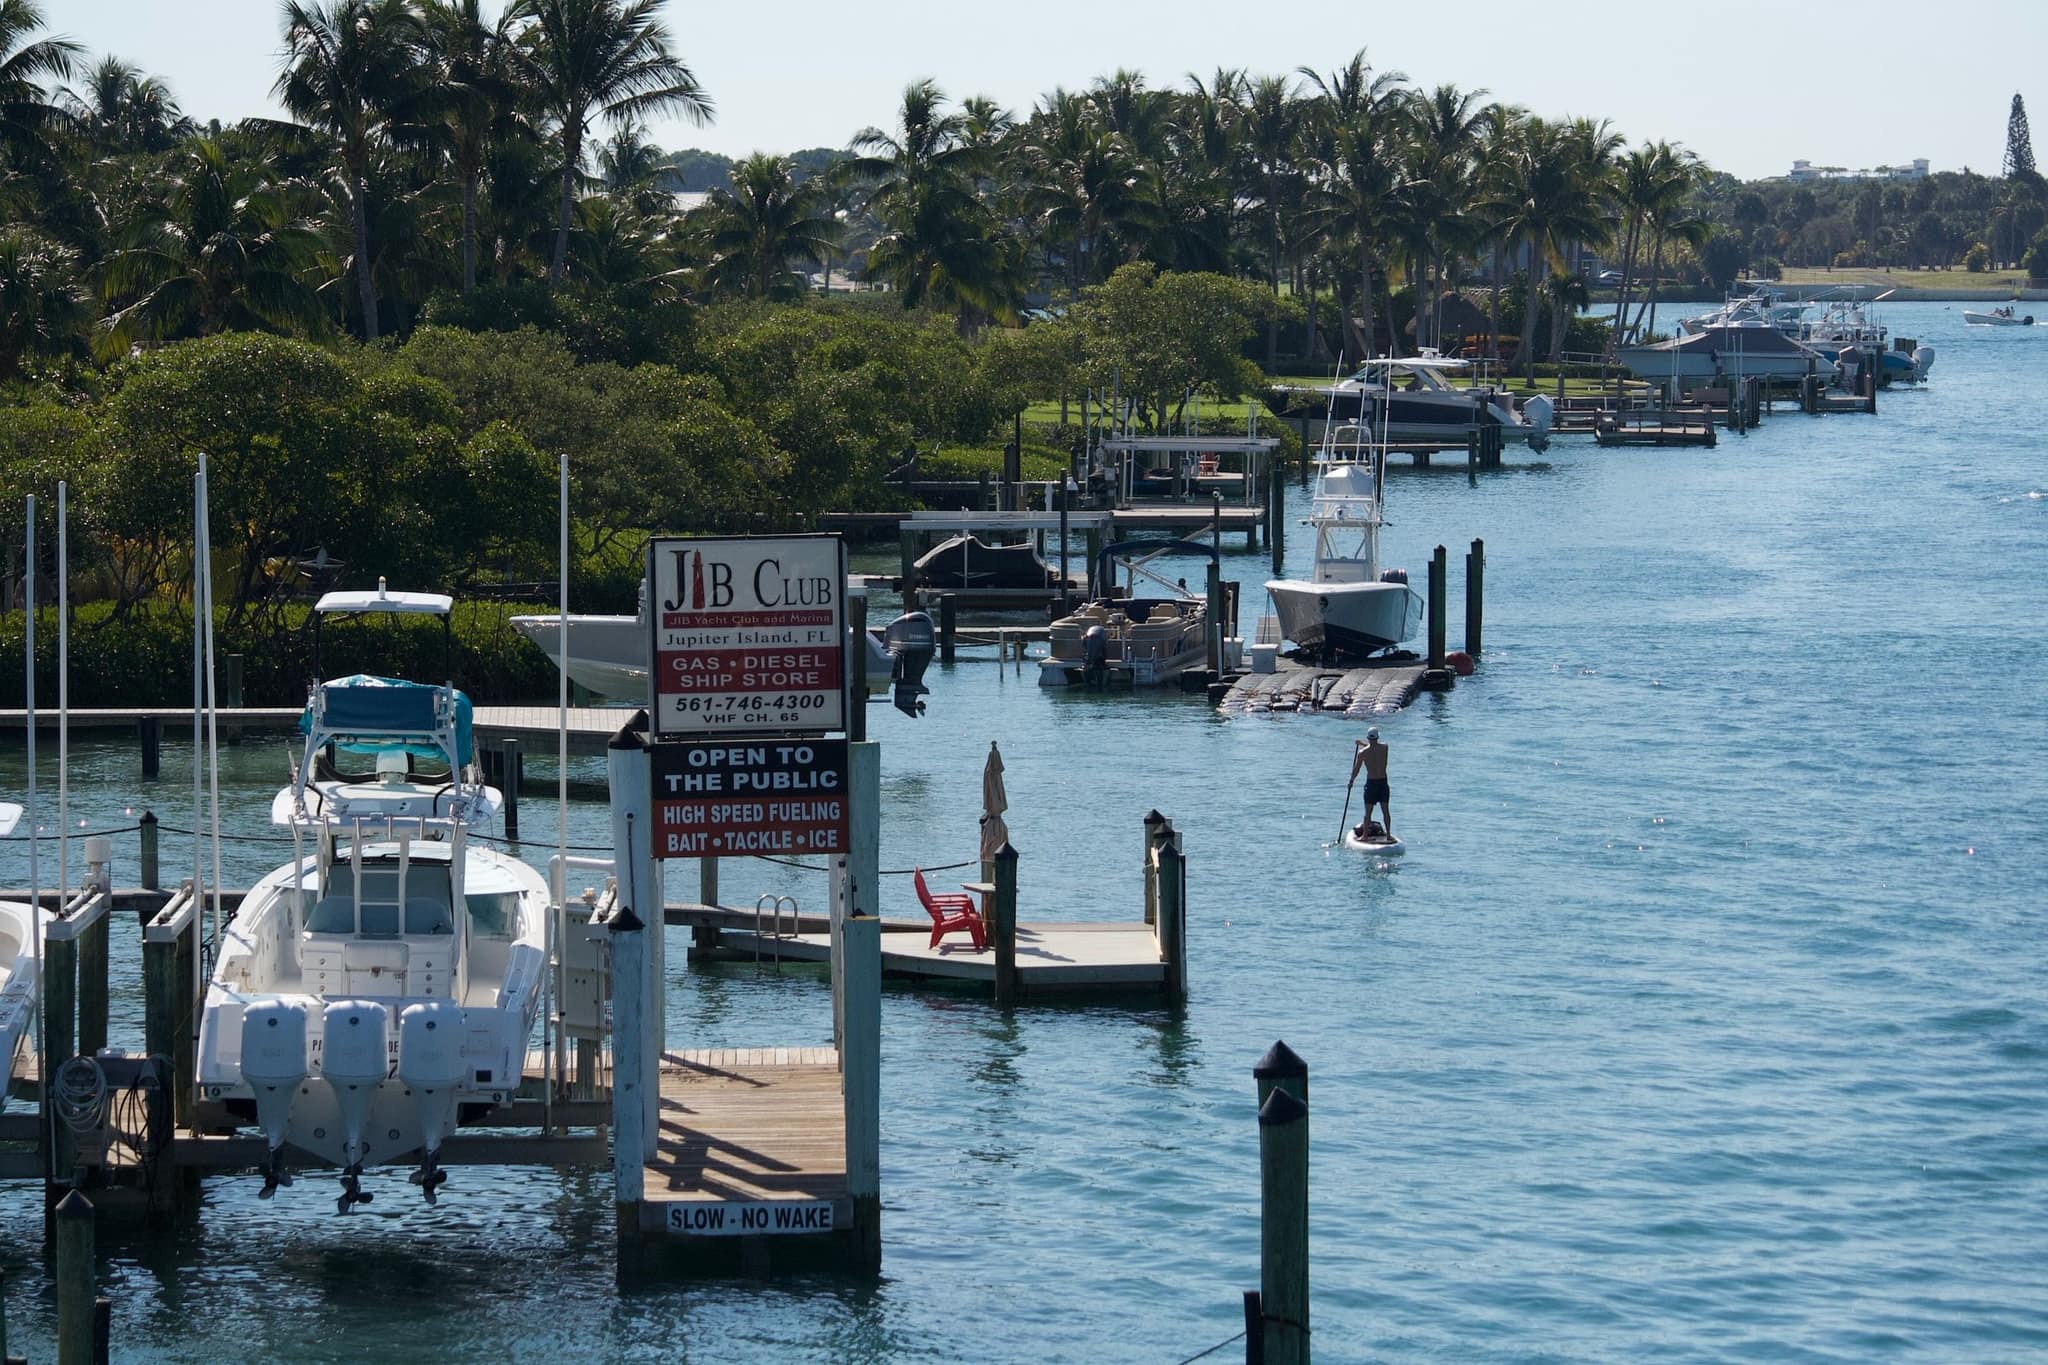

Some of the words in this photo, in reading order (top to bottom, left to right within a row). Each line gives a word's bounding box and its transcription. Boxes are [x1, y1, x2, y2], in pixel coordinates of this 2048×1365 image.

[670, 616, 690, 625] JIB
[694, 615, 727, 625] Yacht
[732, 614, 759, 624] Club
[763, 614, 786, 623] and
[790, 613, 830, 623] Marina
[666, 633, 730, 648] Jupiter
[738, 631, 798, 645] Island,
[807, 631, 830, 643] FL
[672, 657, 720, 671] GAS
[744, 655, 826, 669] DIESEL
[680, 674, 733, 688] SHIP
[742, 672, 820, 686] STORE
[676, 694, 825, 712] 561-746-4300
[703, 714, 736, 723] VHF
[744, 713, 773, 723] CH.
[780, 712, 799, 722] 65
[688, 748, 766, 767] OPEN
[776, 747, 814, 764] TO
[665, 773, 722, 792] THE
[733, 770, 838, 790] PUBLIC
[663, 805, 705, 825] HIGH
[711, 804, 764, 824] SPEED
[769, 802, 840, 822] FUELING
[667, 832, 708, 852] BAIT
[724, 830, 793, 850] TACKLE
[809, 830, 837, 848] ICE
[671, 1208, 725, 1229] SLOW
[742, 1207, 769, 1229] NO
[775, 1207, 831, 1229] WAKE
